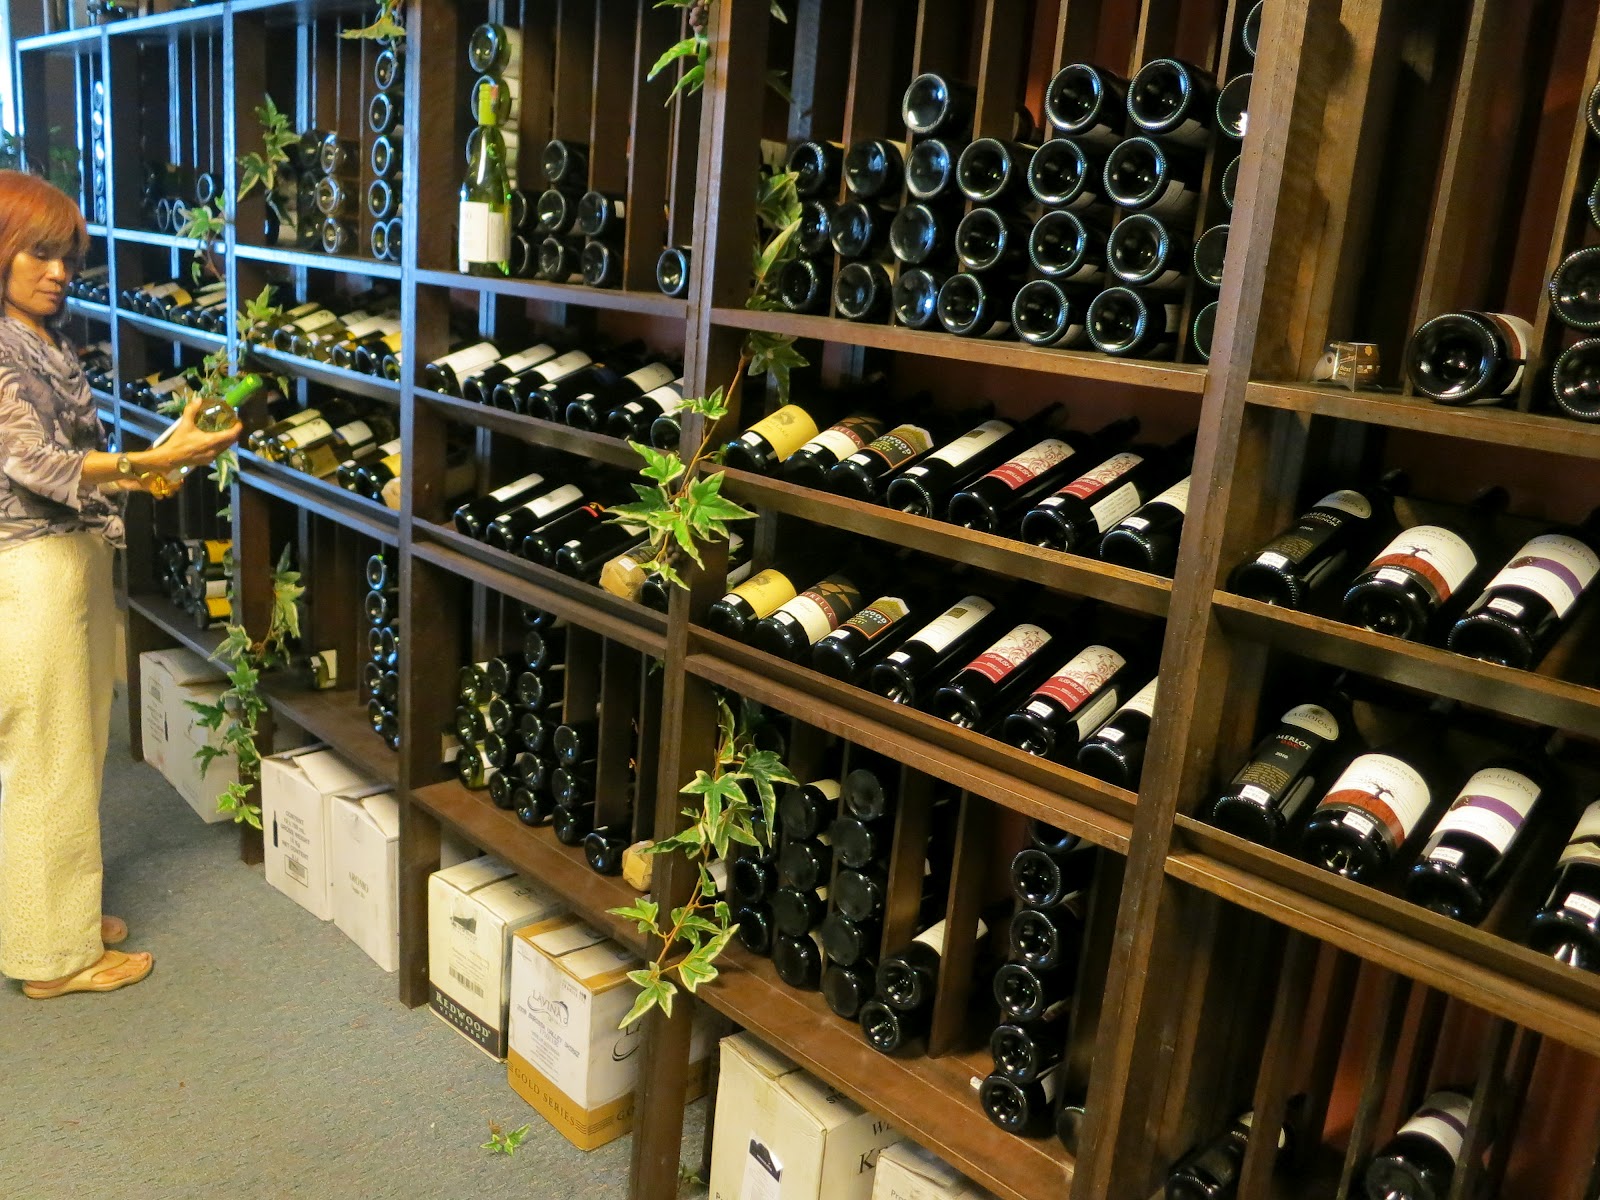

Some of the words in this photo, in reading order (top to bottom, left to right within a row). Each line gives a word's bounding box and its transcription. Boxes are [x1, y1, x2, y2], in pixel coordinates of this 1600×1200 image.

[1276, 734, 1312, 751] MERLOT
[436, 991, 489, 1037] REDWOOD
[514, 1067, 540, 1095] GOLD
[542, 1092, 576, 1127] SERIES
